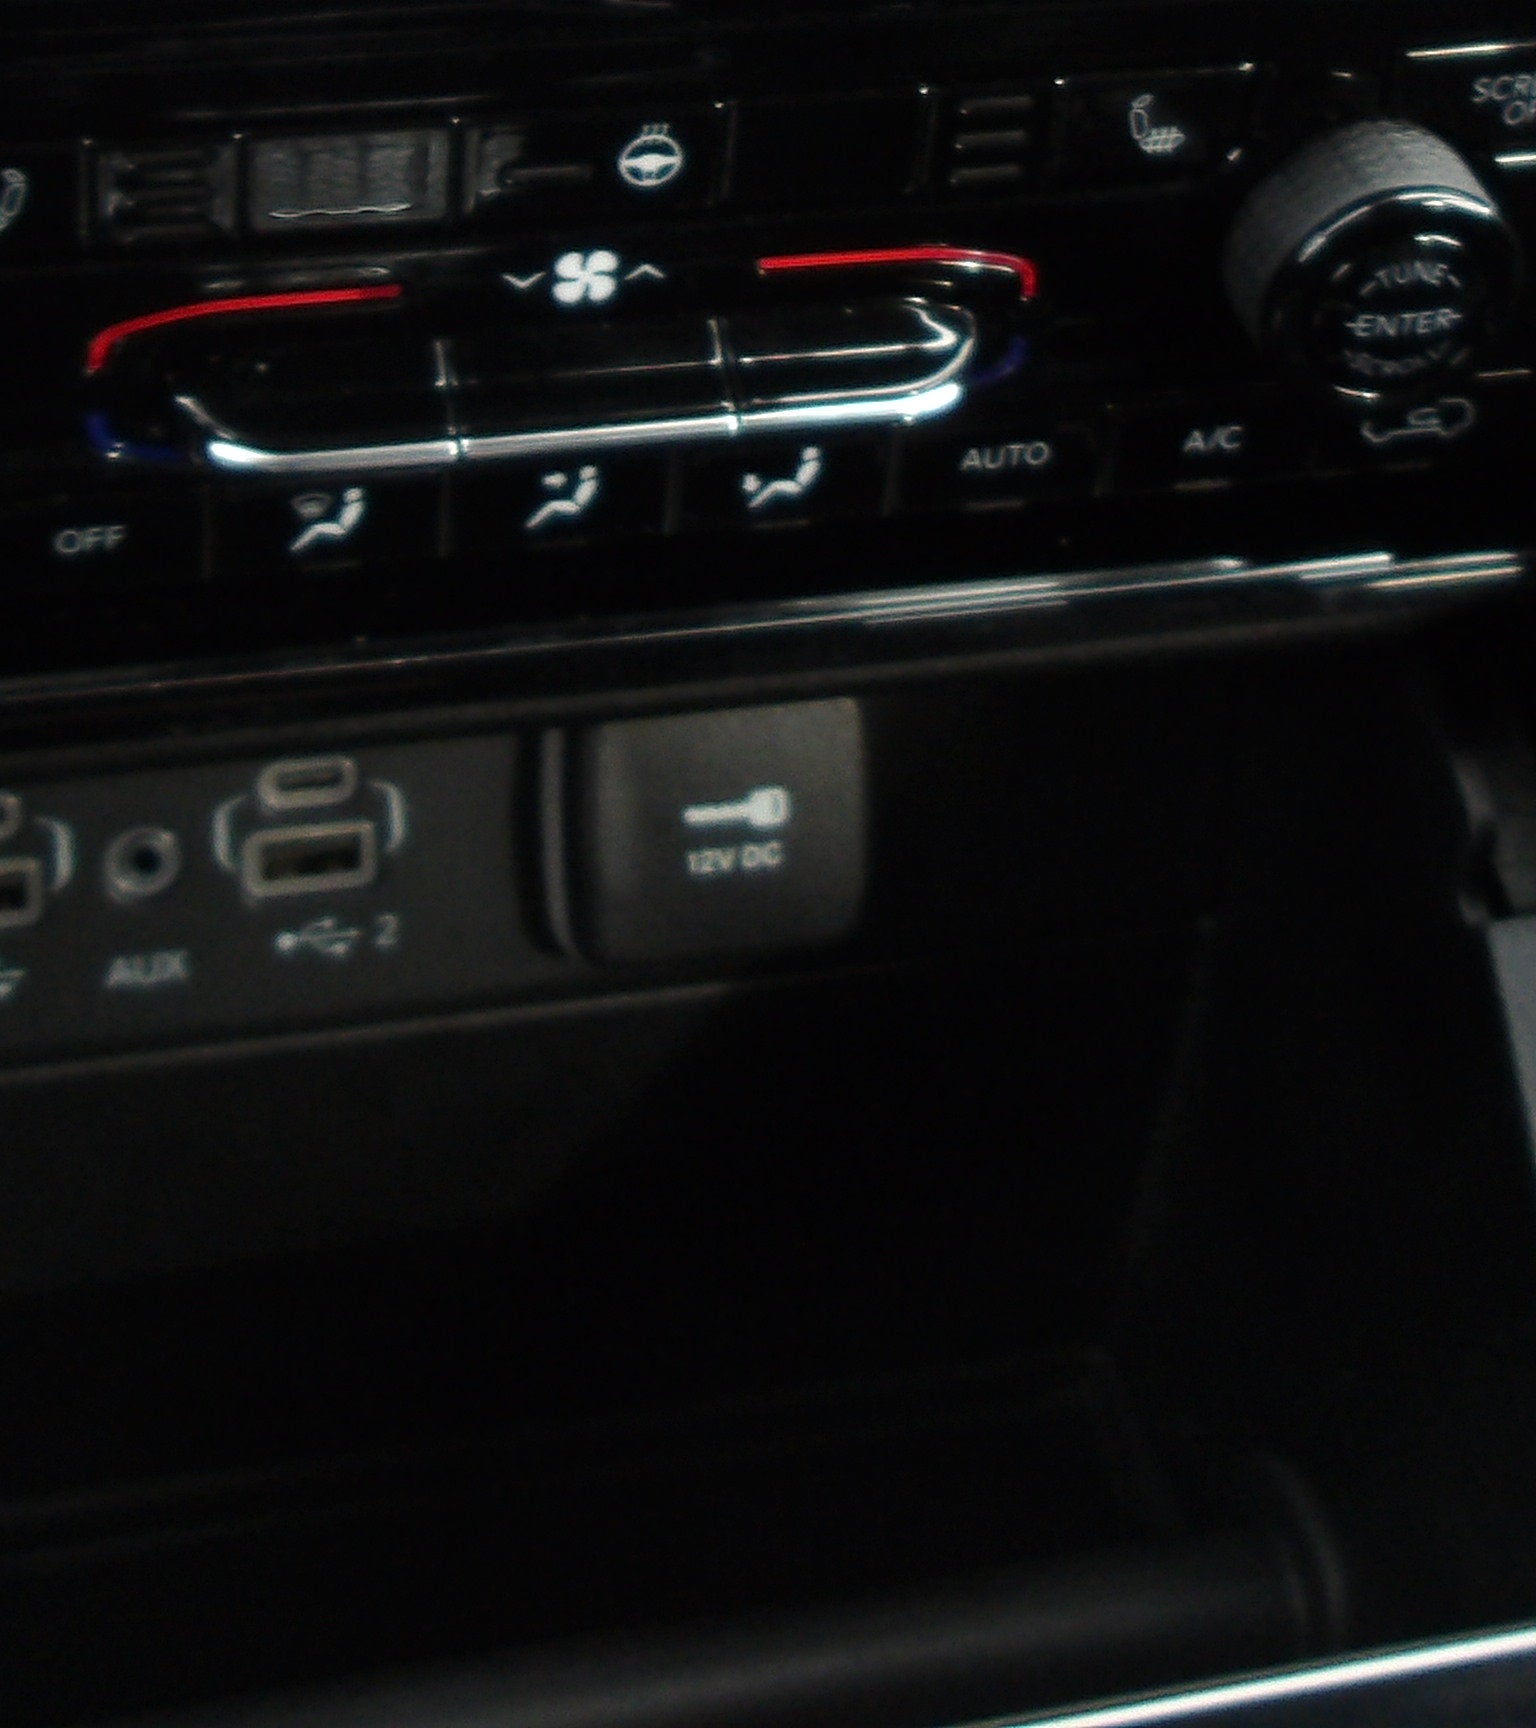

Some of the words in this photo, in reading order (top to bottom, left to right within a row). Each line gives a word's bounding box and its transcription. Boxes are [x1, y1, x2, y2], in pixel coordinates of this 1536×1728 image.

[1352, 307, 1456, 337] ENTER
[1182, 424, 1244, 454] A/C
[960, 440, 1052, 472] AUTO
[53, 524, 127, 556] OFF
[687, 844, 731, 874] 12V
[739, 841, 783, 870] DC
[374, 914, 398, 948] 2
[105, 952, 189, 989] AUX
